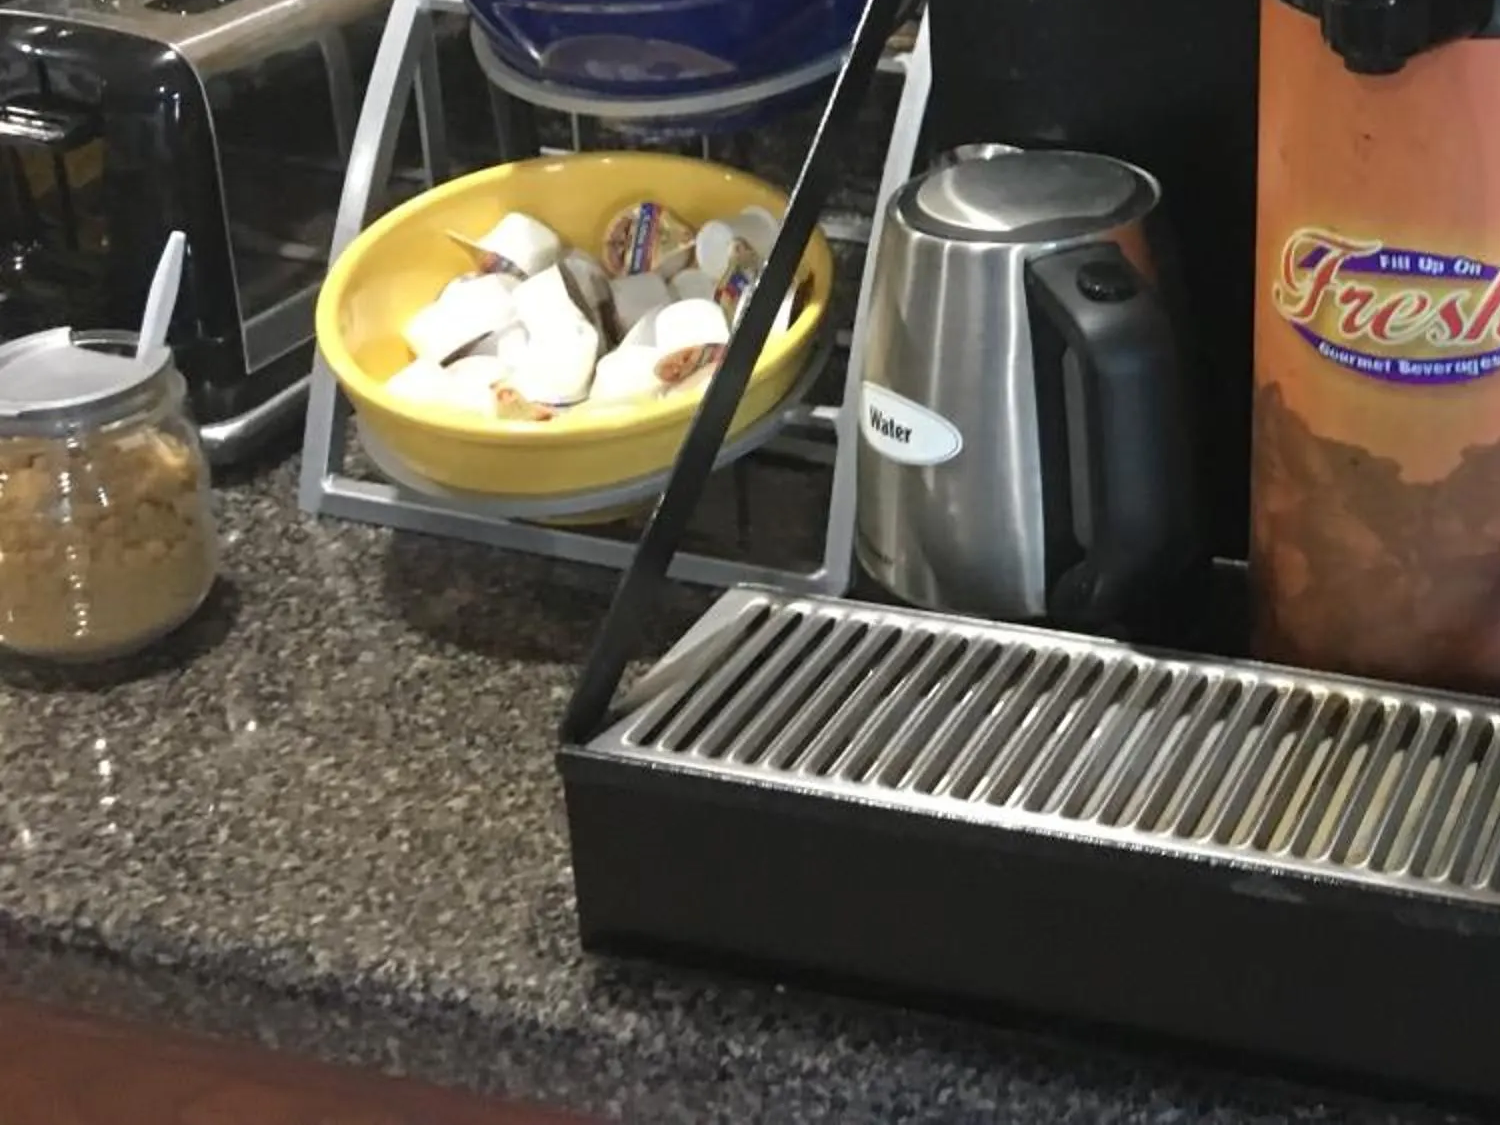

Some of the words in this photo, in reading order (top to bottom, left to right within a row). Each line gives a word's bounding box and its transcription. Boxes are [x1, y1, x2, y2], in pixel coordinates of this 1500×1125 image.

[1379, 254, 1410, 272] Fill
[1418, 257, 1445, 274] Up
[1453, 259, 1483, 275] On
[1318, 341, 1392, 374] Gourmet
[869, 403, 912, 443] Water
